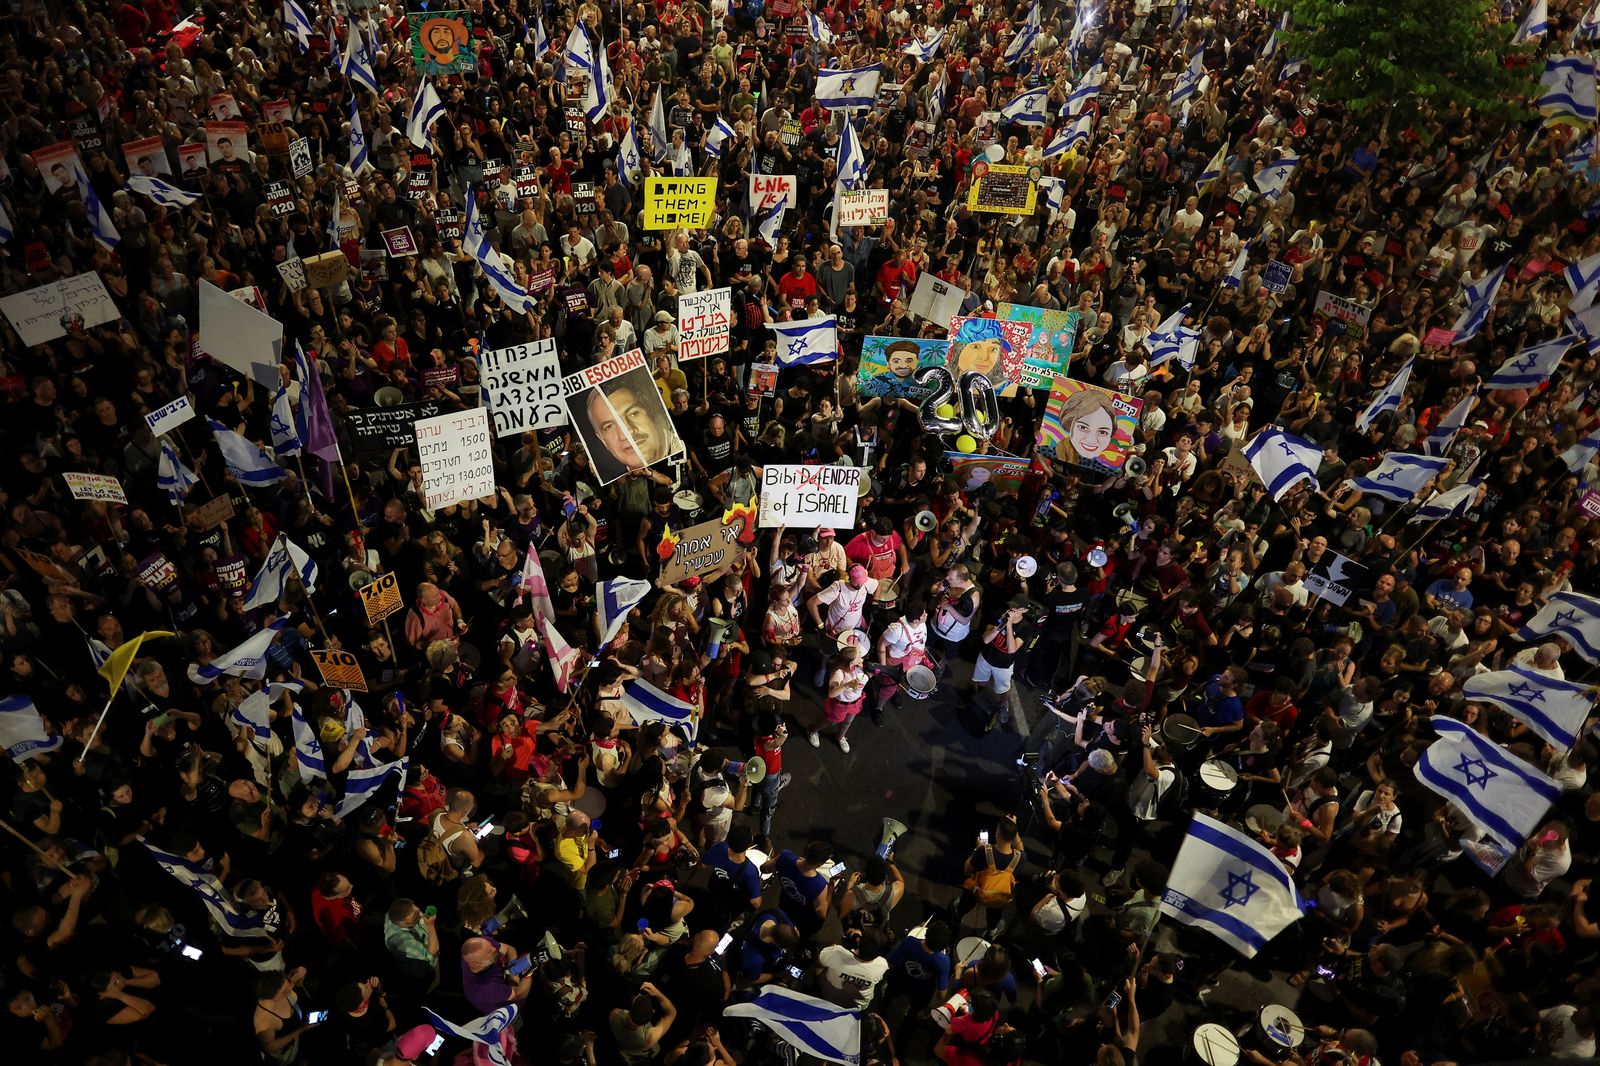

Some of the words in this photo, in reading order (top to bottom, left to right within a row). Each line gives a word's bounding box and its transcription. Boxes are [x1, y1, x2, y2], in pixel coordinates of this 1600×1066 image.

[270, 183, 281, 193] רק
[484, 178, 501, 190] 120
[518, 185, 538, 196] 120
[654, 183, 706, 195] BRING
[267, 188, 290, 201] עסקה
[408, 190, 426, 200] 120
[573, 190, 594, 199] עסקה
[272, 201, 296, 215] 120
[575, 203, 596, 213] 120
[654, 199, 698, 210] THEM
[436, 216, 457, 225] עסקה
[654, 213, 705, 226] HOME!
[682, 312, 728, 332] מנדט
[680, 330, 695, 342] לא
[584, 350, 645, 386] ESCOBAR
[487, 365, 555, 391] ממשלה
[421, 403, 439, 417] לא
[1113, 400, 1136, 416] קרינה
[348, 414, 364, 425] כי
[493, 404, 562, 432] בעמה
[356, 424, 401, 436] שינתה
[386, 434, 415, 446] פניה
[461, 432, 487, 447] 1500
[420, 441, 448, 457] מתים
[469, 449, 488, 462] 120
[765, 467, 797, 486] Bibi
[463, 484, 474, 497] לא
[479, 480, 492, 493] זה
[773, 492, 789, 516] of
[795, 493, 849, 514] ISRAEL
[720, 525, 740, 545] אי
[675, 534, 712, 567] אמון
[216, 560, 245, 574] המלחמה
[684, 549, 725, 575] עכשיו
[145, 561, 175, 588] רעה
[217, 567, 246, 582] רעה
[361, 575, 395, 601] 7.10
[1327, 581, 1351, 598] DOWN
[313, 652, 357, 667] 7.10
